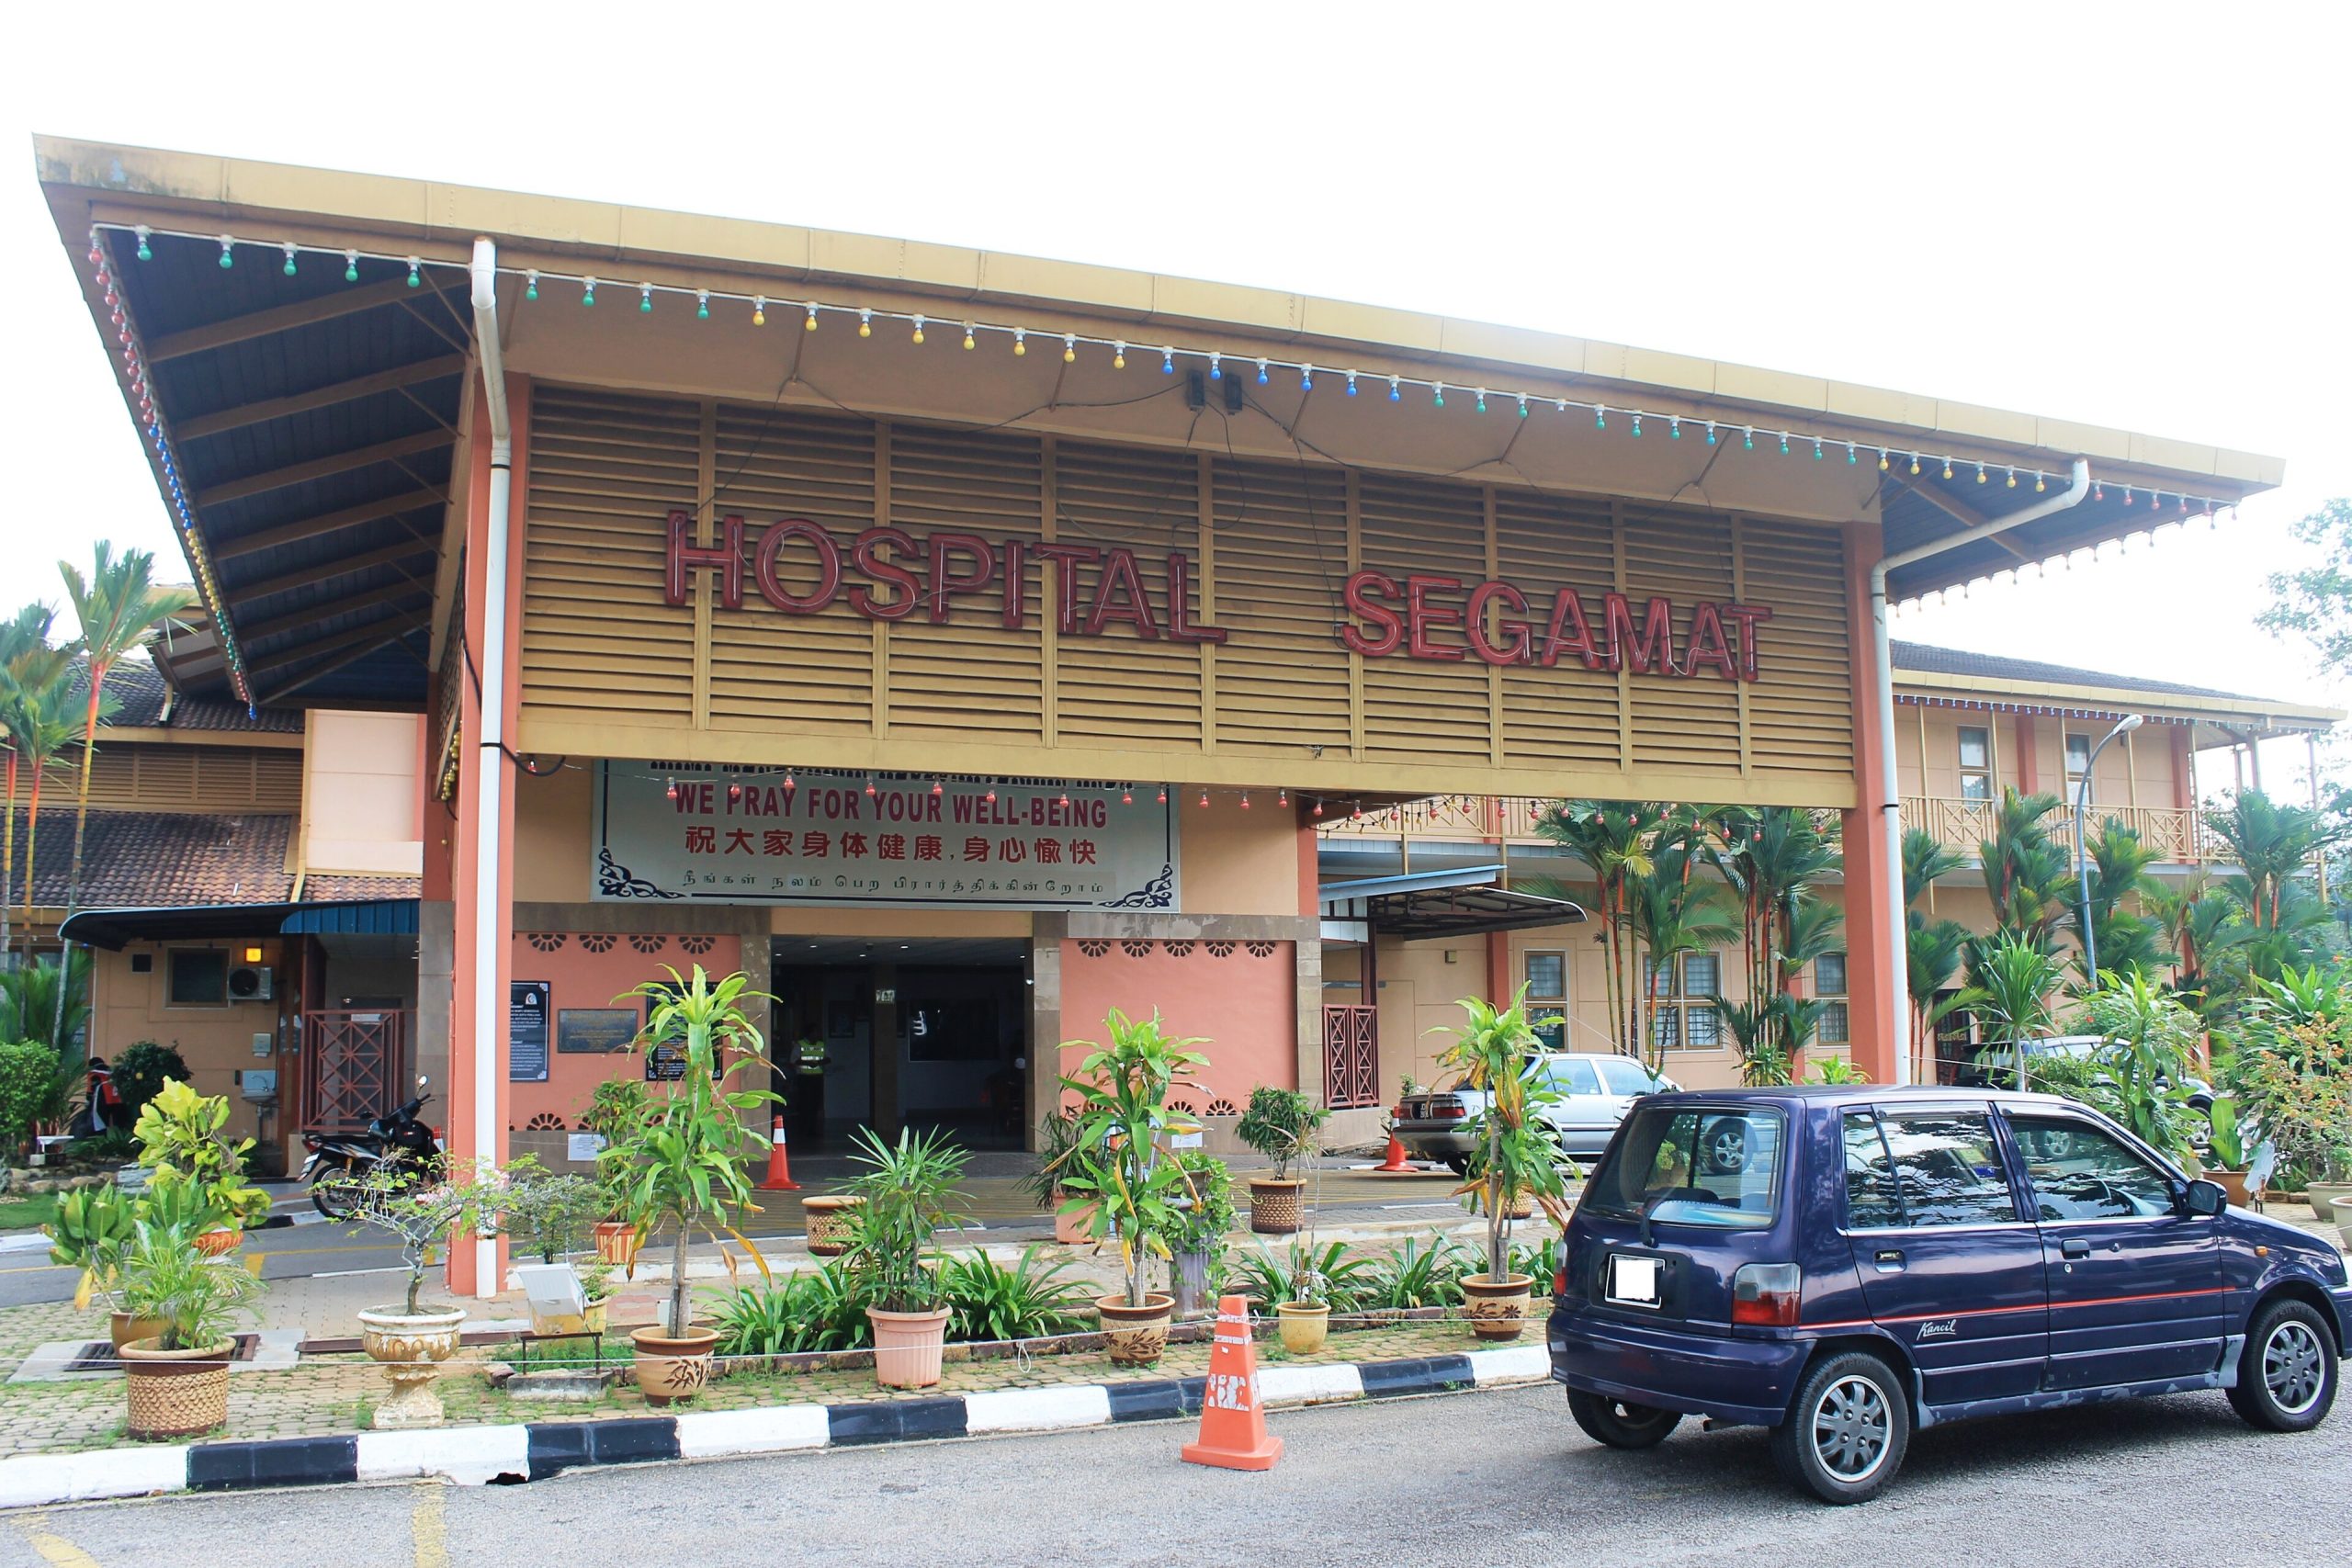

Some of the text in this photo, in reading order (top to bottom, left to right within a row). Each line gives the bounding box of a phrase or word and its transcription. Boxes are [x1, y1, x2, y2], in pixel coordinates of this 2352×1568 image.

[665, 509, 1774, 682] HOSPITAL SEGAMAT
[675, 784, 1107, 829] WE PRAY FOR YOUR WELL-BEING
[683, 869, 758, 887] நீங்கள்
[772, 876, 822, 890] நலம்
[834, 874, 880, 892] பெற
[1916, 1318, 1957, 1341] Kancil
